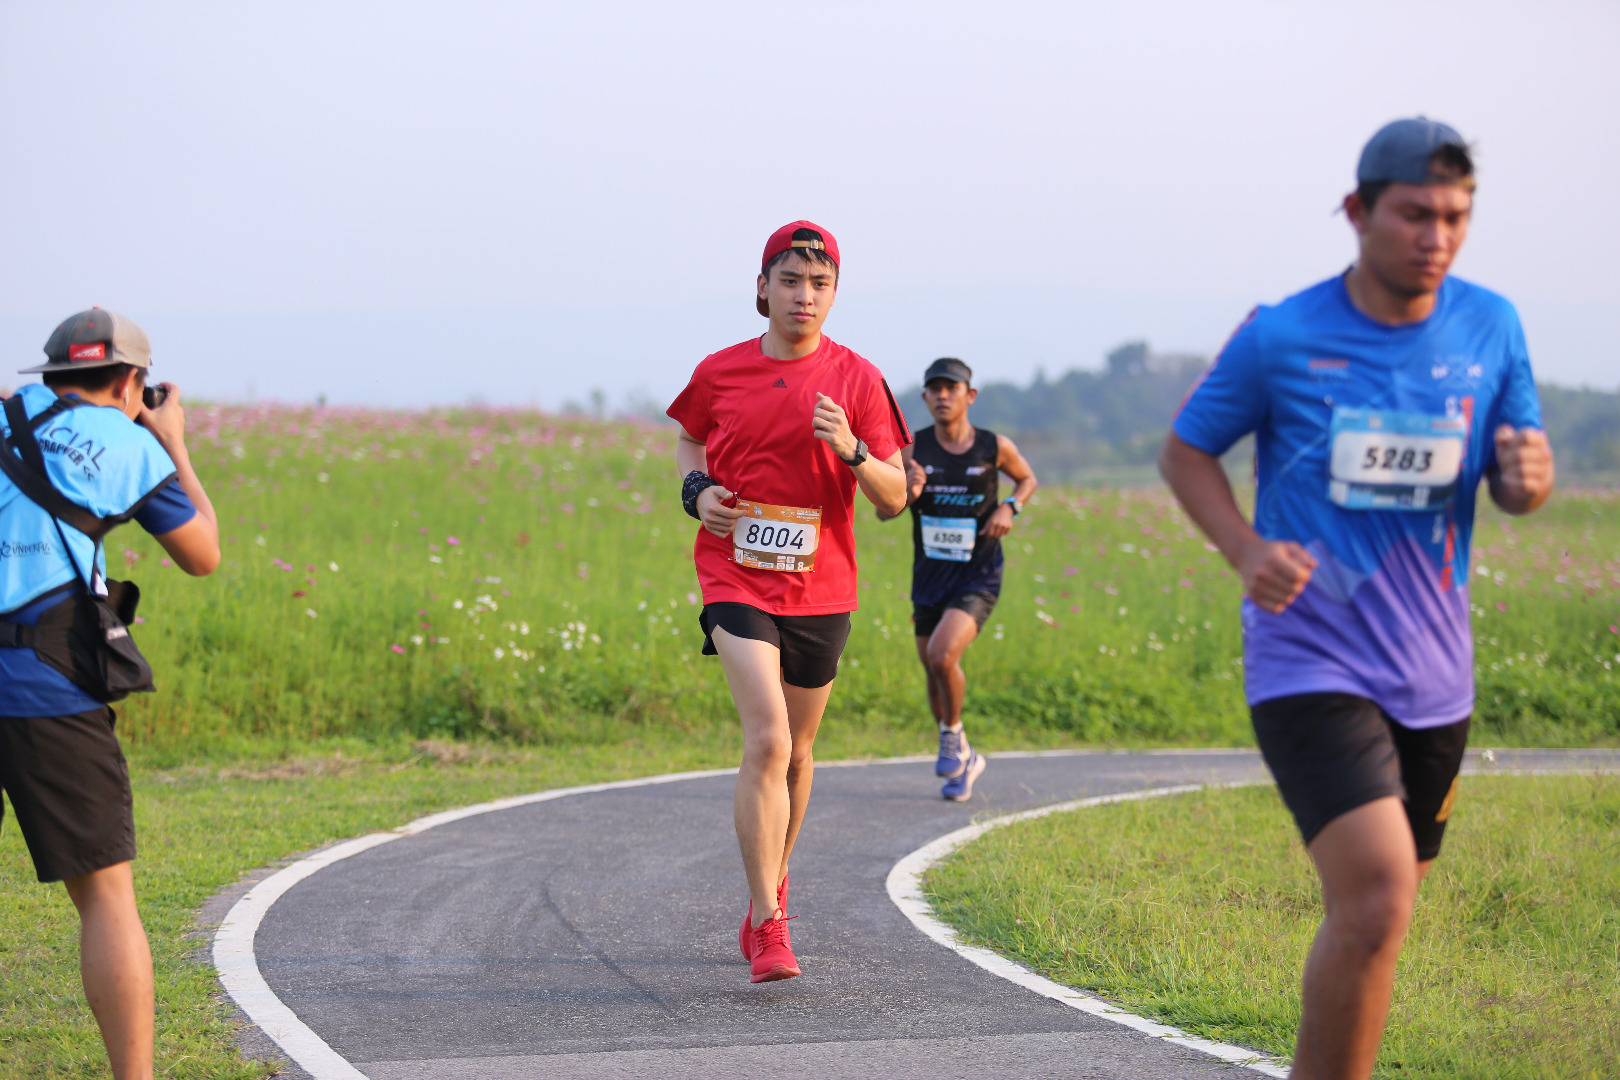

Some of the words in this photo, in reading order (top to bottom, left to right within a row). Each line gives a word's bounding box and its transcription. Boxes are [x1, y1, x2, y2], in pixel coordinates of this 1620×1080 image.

[40, 420, 107, 472] ICIAL
[1361, 446, 1434, 473] 5283
[746, 523, 804, 550] 8004
[933, 532, 963, 544] 6308
